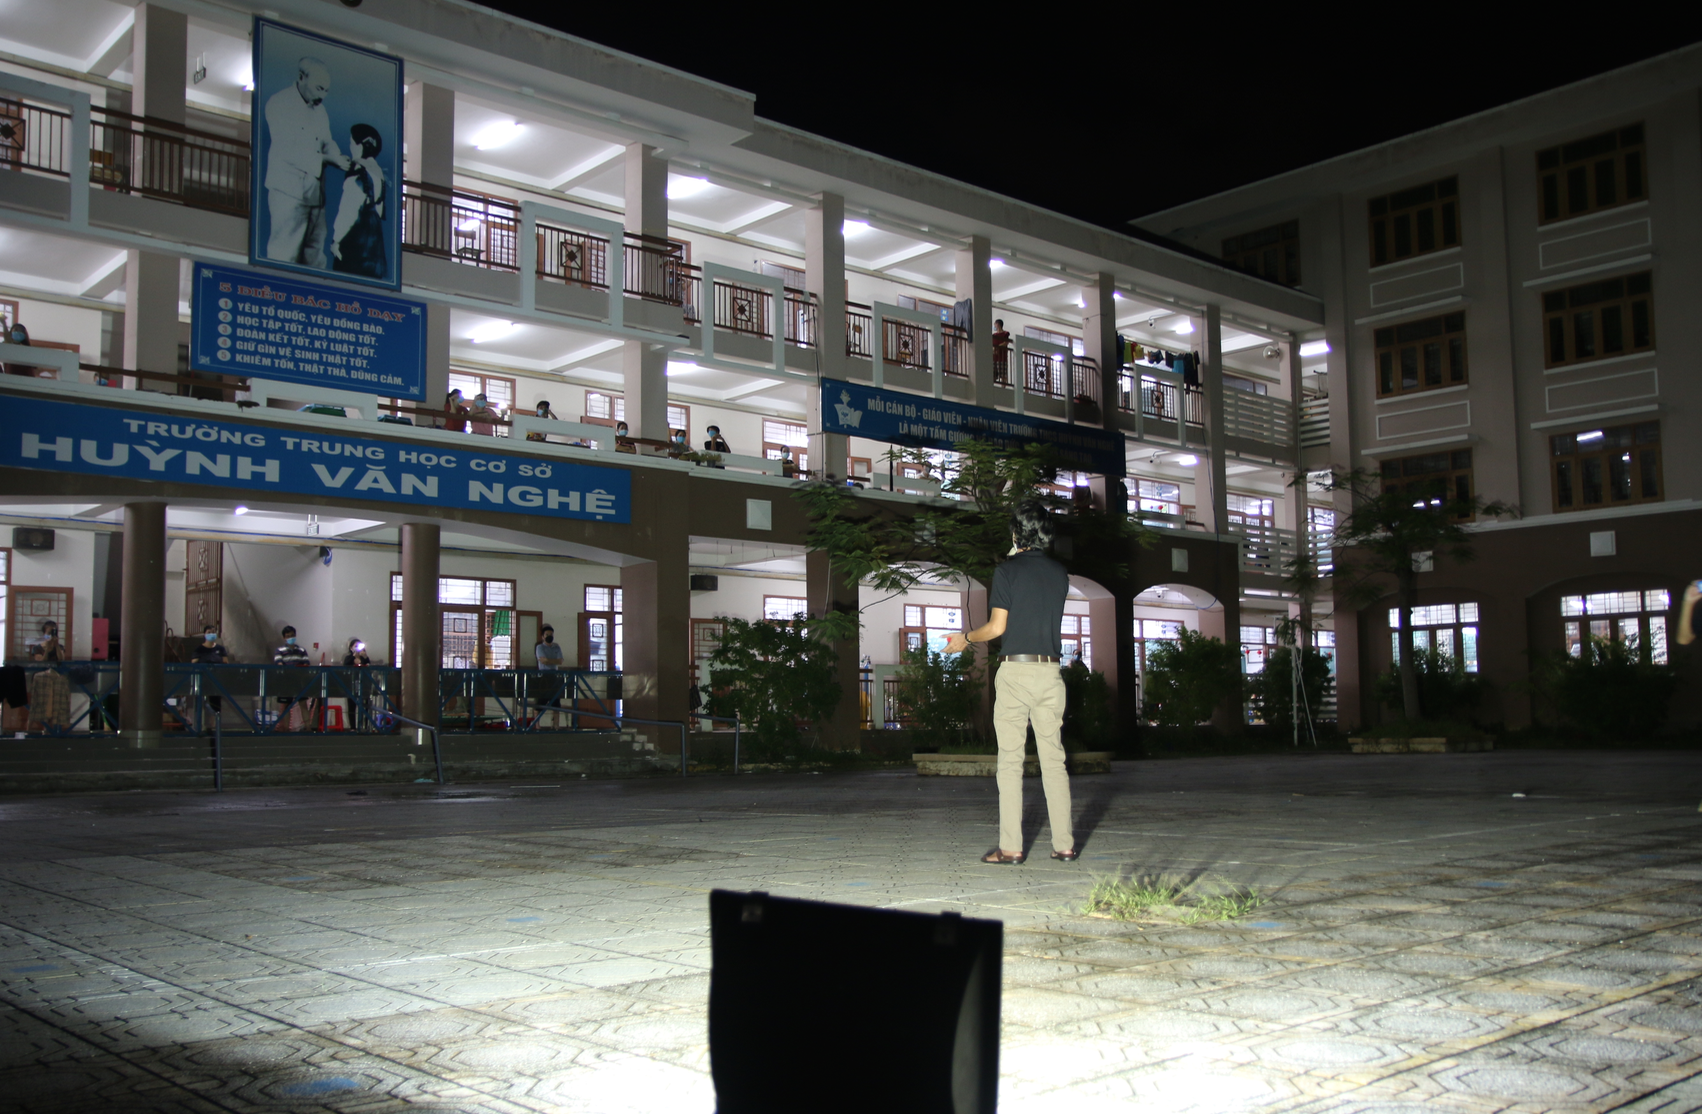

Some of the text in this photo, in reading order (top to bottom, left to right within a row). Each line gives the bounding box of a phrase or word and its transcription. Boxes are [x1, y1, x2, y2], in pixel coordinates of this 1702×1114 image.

[219, 282, 406, 323] 5 ĐIỀU BÁC HỒ DẠY
[237, 302, 259, 314] YÊU
[310, 314, 331, 326] YÊU
[236, 315, 260, 327] HỌC
[261, 318, 282, 331] TẬP
[307, 326, 326, 337] LAO
[328, 330, 356, 342] ĐỘNG
[236, 327, 266, 341] ĐOÀN
[268, 332, 289, 344] KẾT
[330, 342, 355, 354] LUẬT
[235, 353, 271, 367] KHIÊM
[298, 362, 325, 375] THẬT
[257, 342, 276, 355] GÌN
[278, 346, 292, 359] VỆ
[294, 349, 319, 361] SINH
[321, 353, 348, 366] THẬT
[867, 395, 884, 413] MỖI
[886, 400, 903, 416] CÁN
[904, 403, 916, 420] BỘ
[922, 407, 942, 422] GIÁO
[943, 410, 962, 426] VIÊN
[967, 415, 989, 431] NHÂN
[989, 418, 1008, 434] VIÊN
[1008, 422, 1038, 438] TRƯỜNG
[898, 420, 908, 435] LÀ
[910, 422, 928, 440] MỘT
[929, 425, 947, 441] TẤM
[123, 418, 552, 478] TRƯỜNG TRUNG HỌC CƠ SỞ
[20, 431, 616, 519] HUỲNH VĂN NGHỆ
